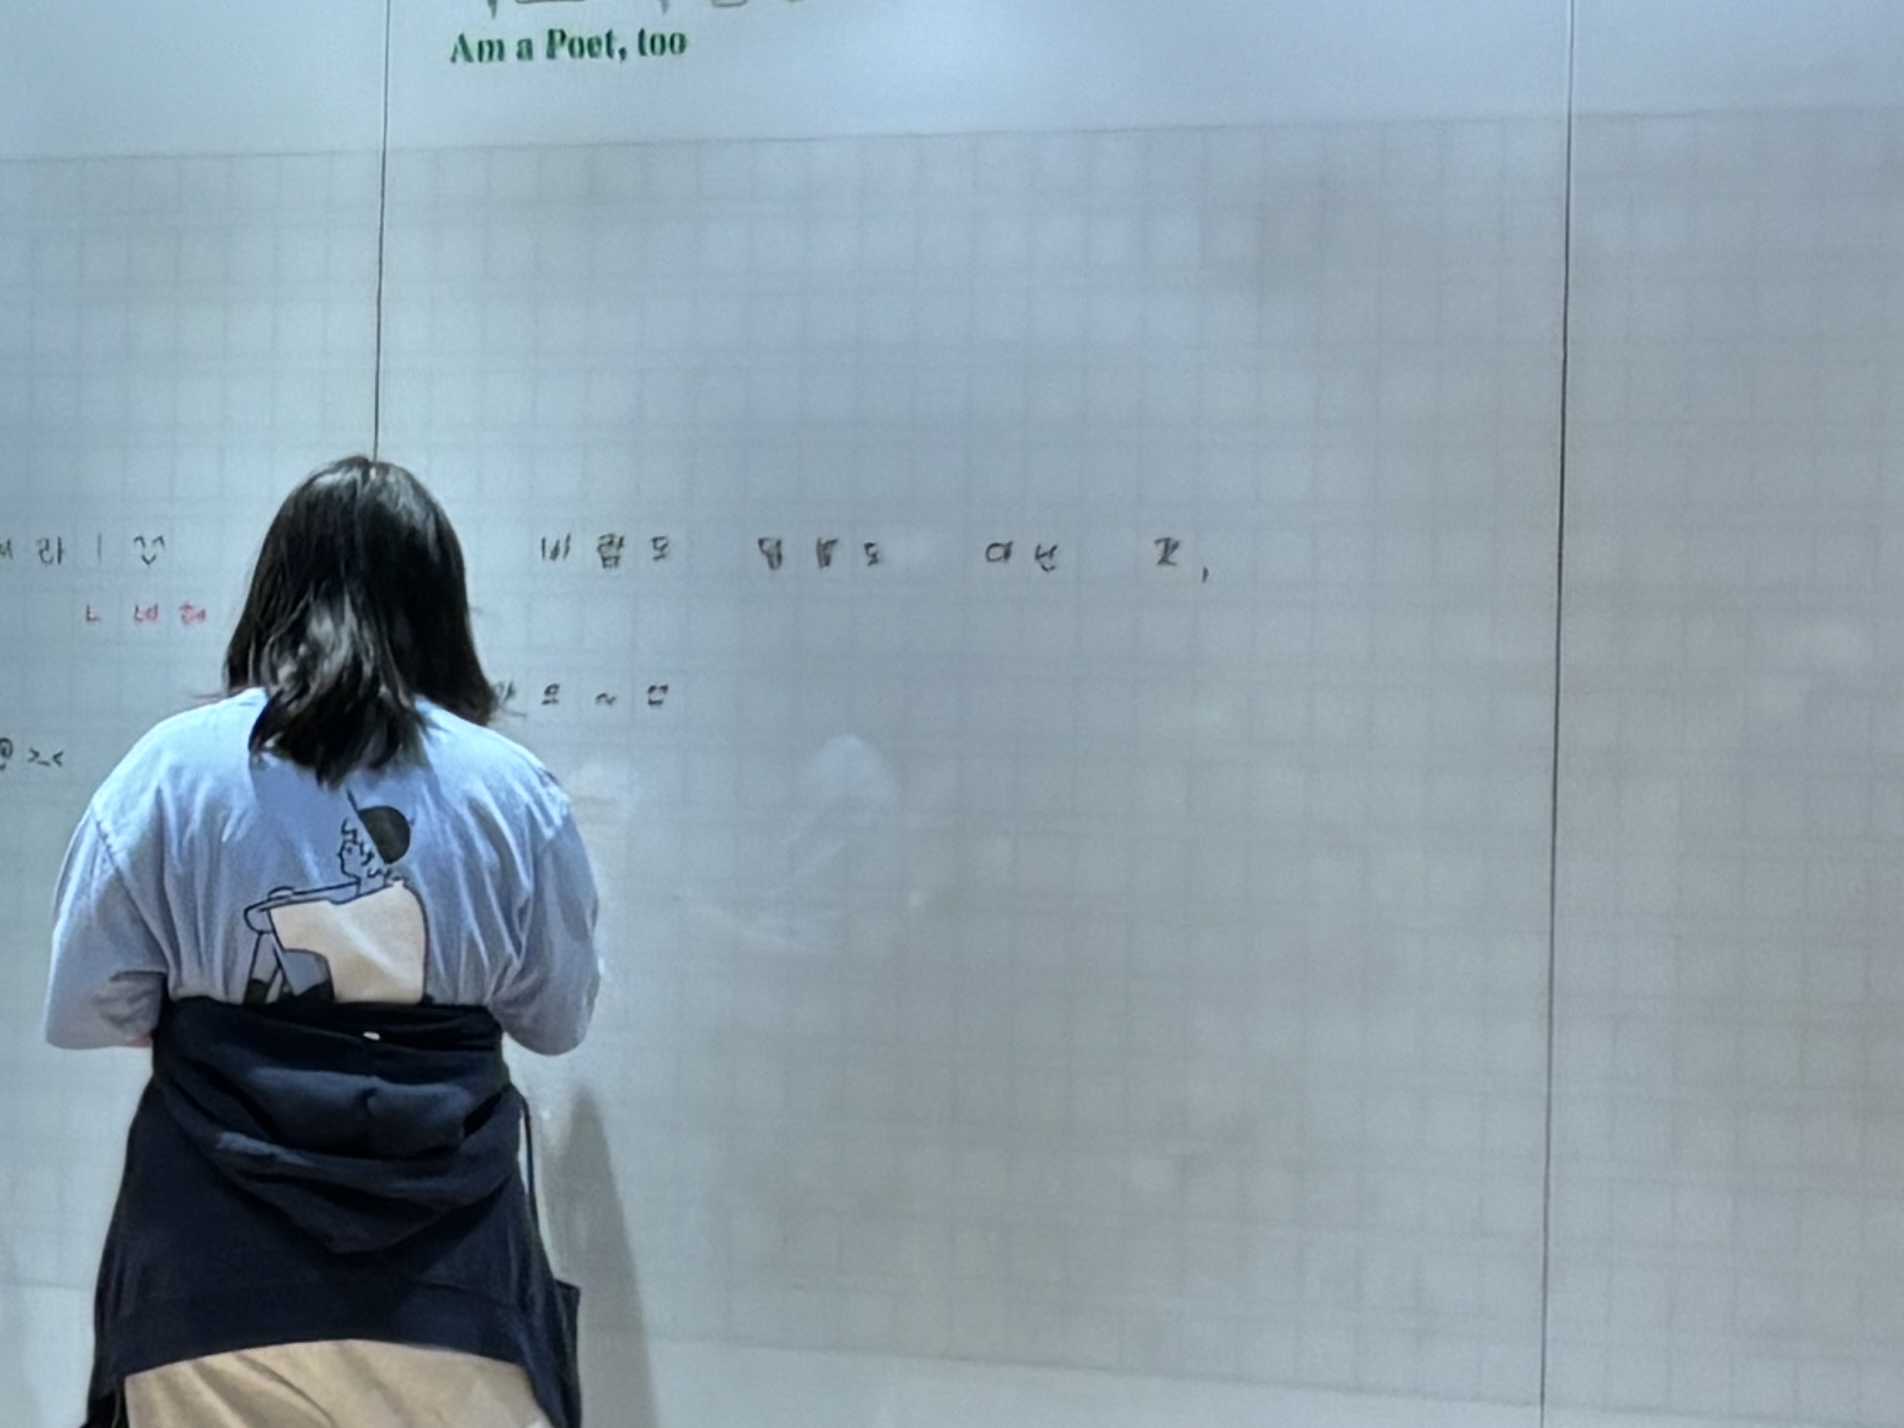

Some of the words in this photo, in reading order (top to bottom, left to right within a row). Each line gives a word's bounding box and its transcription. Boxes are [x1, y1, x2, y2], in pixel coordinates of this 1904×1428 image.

[450, 33, 506, 64] Am
[516, 38, 534, 61] a
[545, 28, 628, 62] Poet,
[637, 28, 688, 57] too
